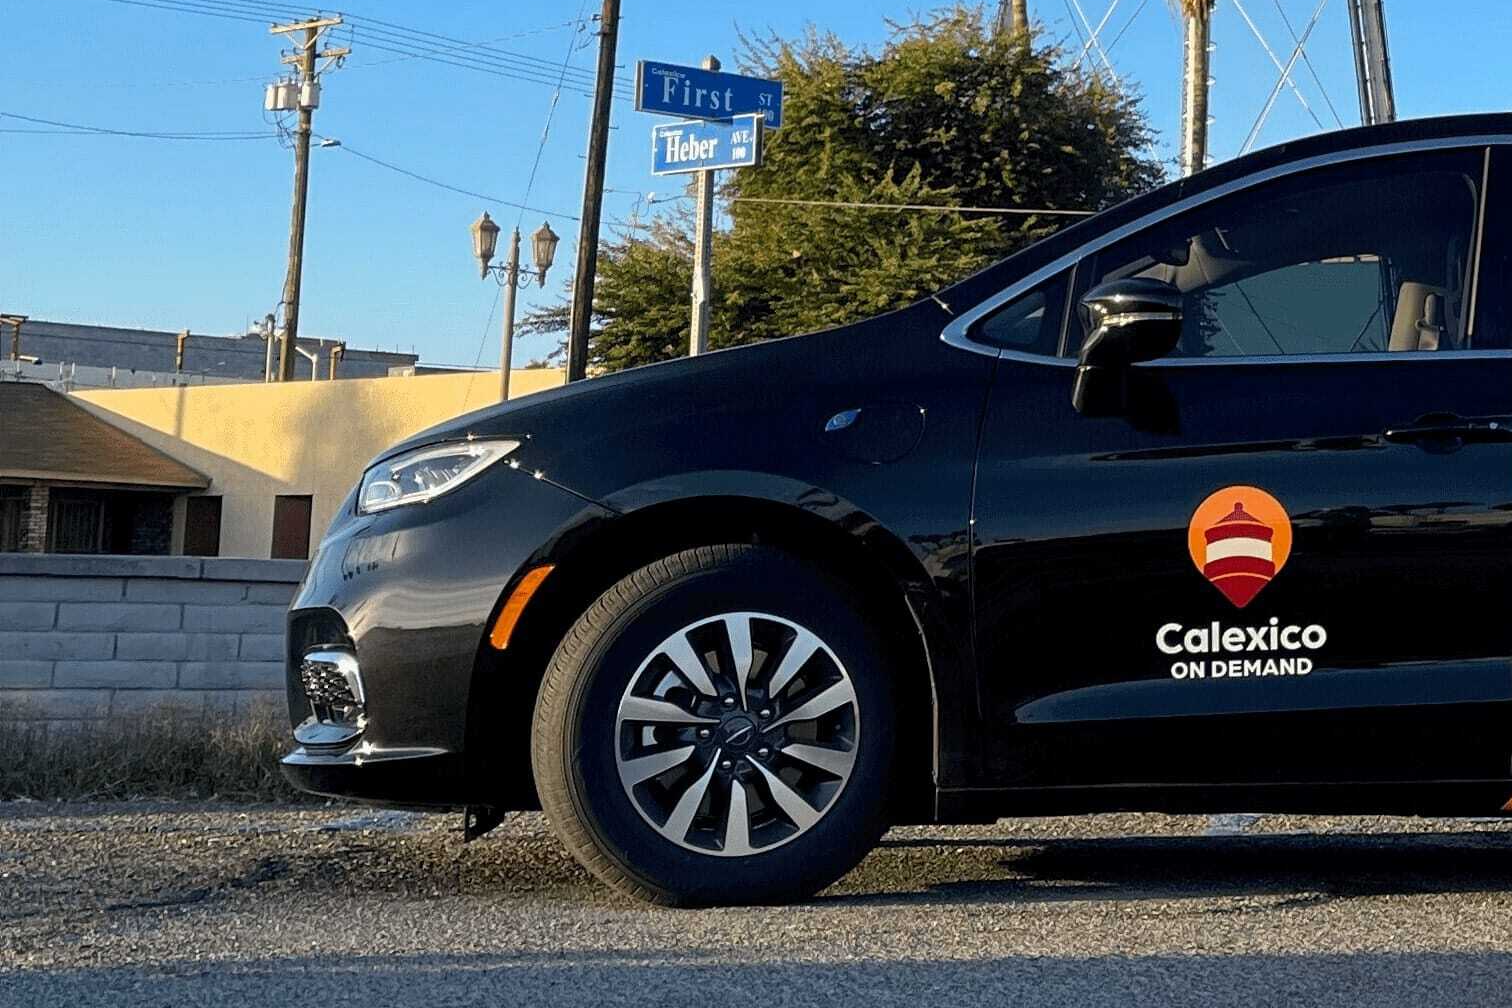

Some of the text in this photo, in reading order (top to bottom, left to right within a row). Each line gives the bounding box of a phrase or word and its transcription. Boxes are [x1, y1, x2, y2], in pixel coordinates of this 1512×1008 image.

[662, 76, 773, 111] First ST
[665, 133, 718, 163] Heber
[1155, 616, 1328, 654] Calexico
[1170, 657, 1313, 679] ON DEMAND
